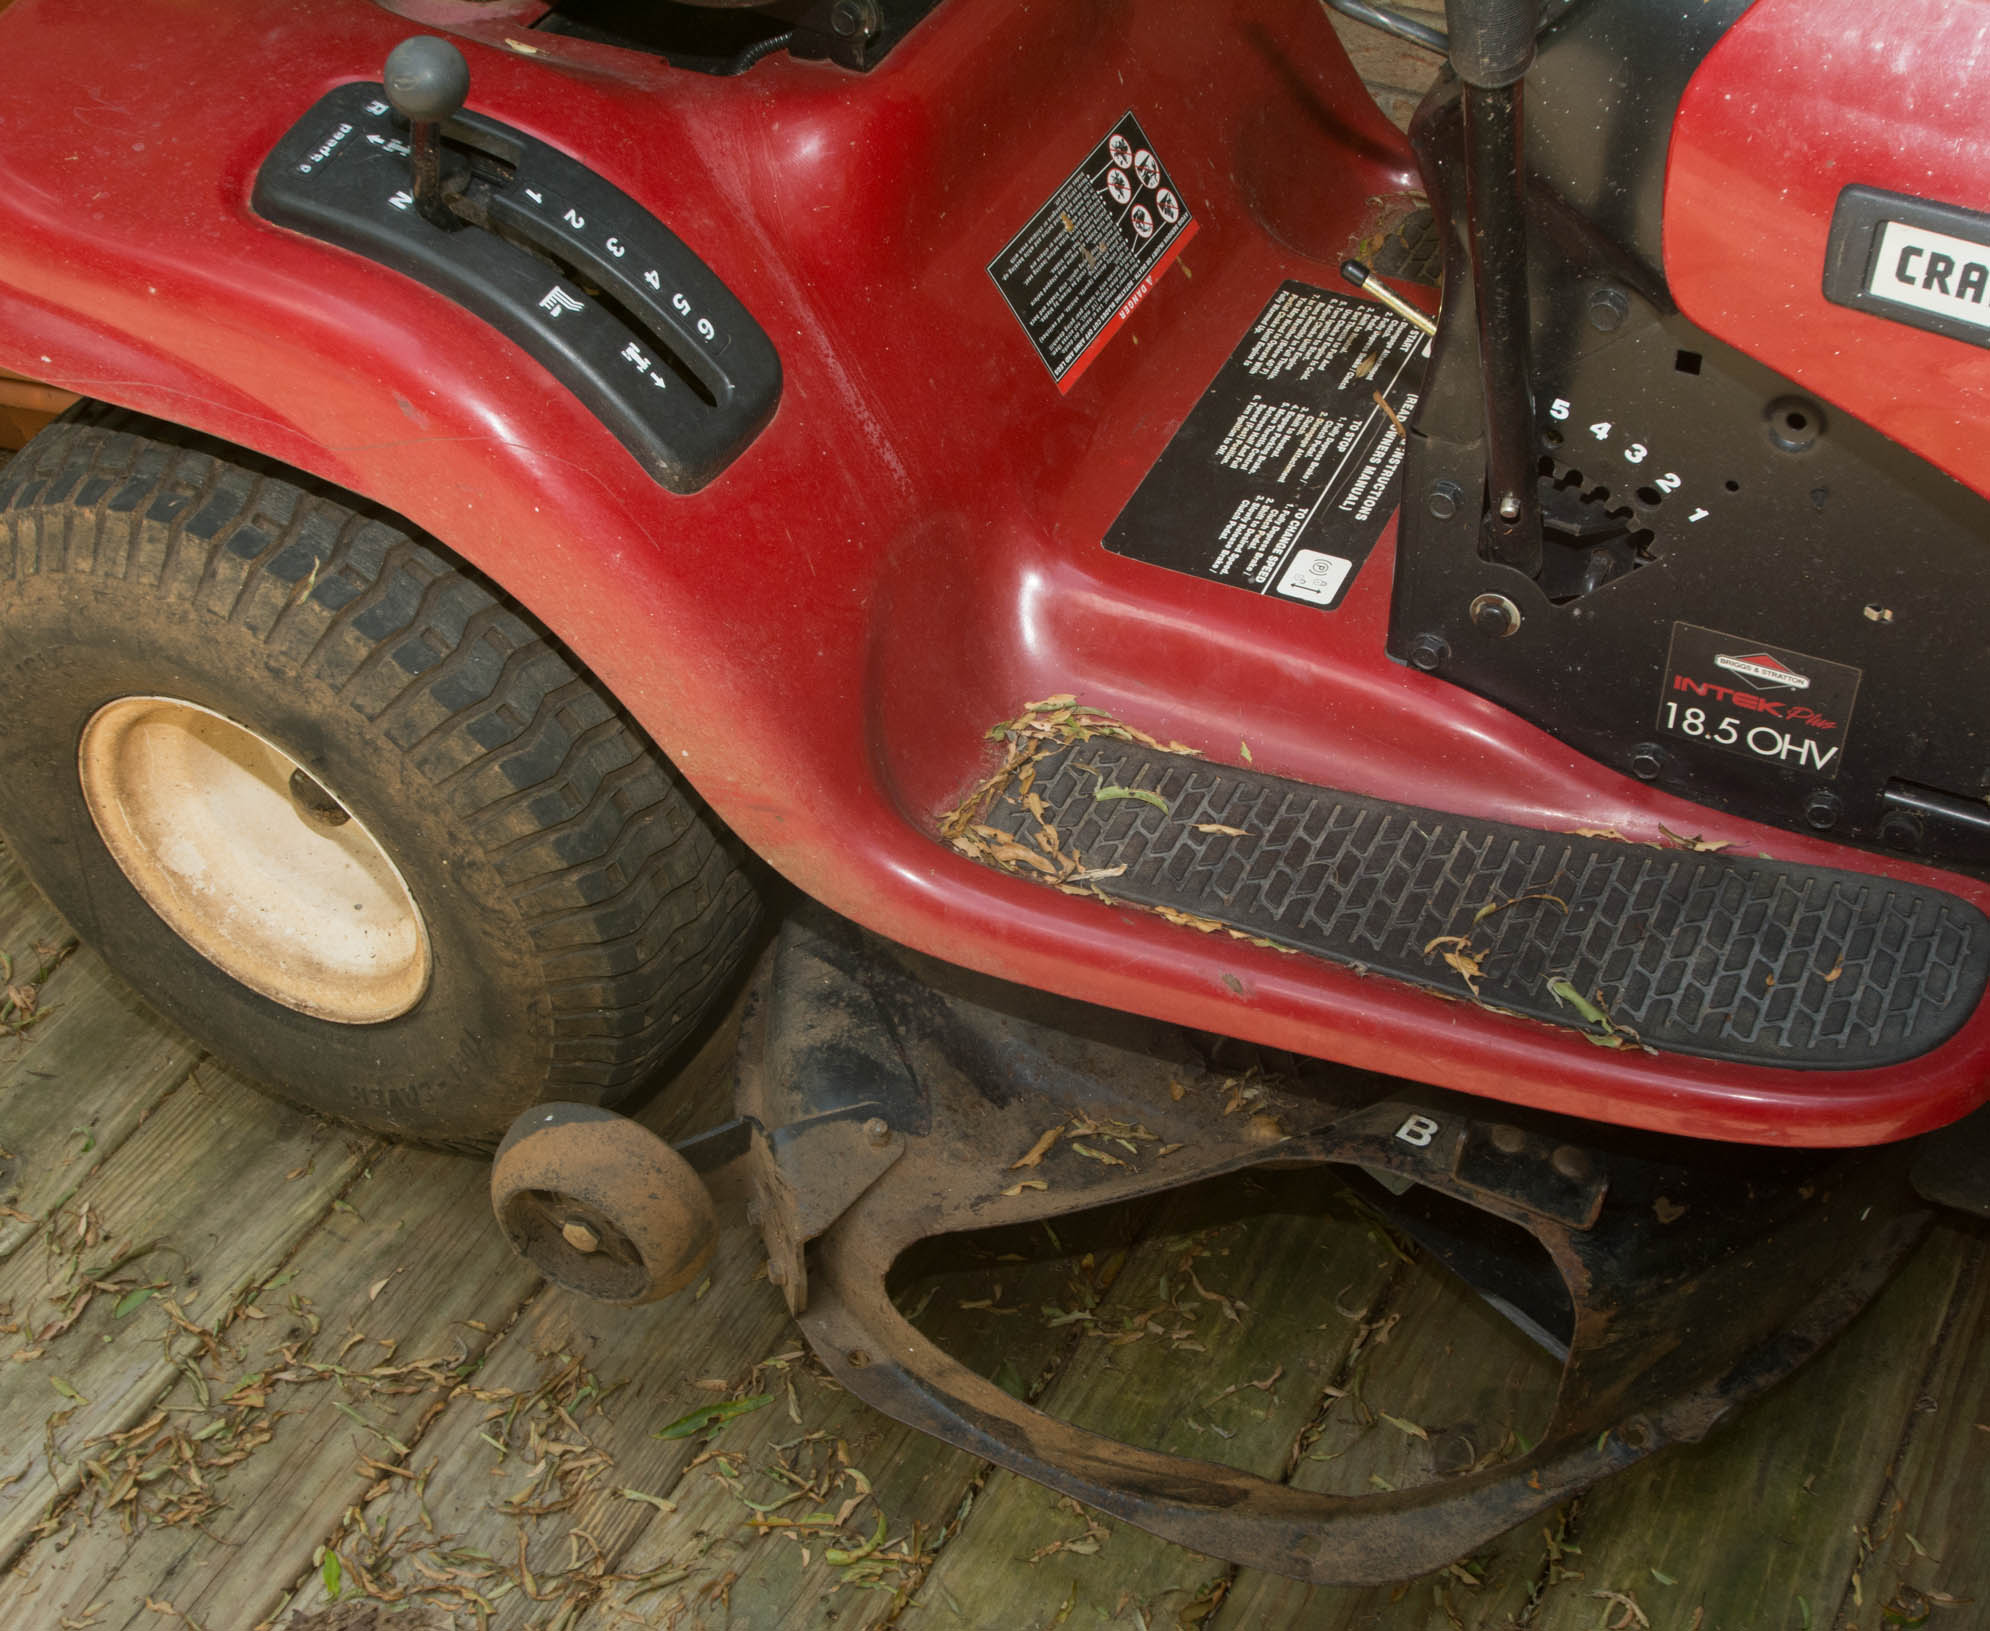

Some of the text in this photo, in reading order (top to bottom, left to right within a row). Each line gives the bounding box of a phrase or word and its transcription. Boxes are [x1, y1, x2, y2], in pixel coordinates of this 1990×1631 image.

[364, 100, 389, 115] R
[388, 190, 413, 210] N
[525, 188, 543, 204] 1
[563, 209, 585, 229] 2
[606, 237, 625, 257] 3
[644, 270, 661, 290] 4
[672, 293, 692, 316] 5
[1119, 284, 1147, 319] DANGER
[697, 318, 715, 340] 6
[1399, 329, 1420, 352] START
[1054, 360, 1066, 376] LEGS
[1242, 401, 1257, 414] Turn
[1249, 403, 1267, 422] Speed
[1270, 408, 1286, 424] Move
[1550, 398, 1571, 420] 5
[1227, 415, 1248, 437] Ignition
[1276, 411, 1295, 432] Engage
[1295, 415, 1314, 436] Clutch.
[1299, 417, 1324, 448] Disengage
[1328, 422, 1343, 437] Fully
[1589, 422, 1612, 440] 4
[1229, 406, 1276, 469] Between Half And Full
[1254, 424, 1276, 447] Throttle
[1260, 432, 1281, 455] Parking
[1304, 420, 1334, 458] Clutch Pedal.
[1335, 420, 1362, 452] TO STOP
[1239, 448, 1260, 470] Control
[1313, 437, 1334, 461] Depress
[1624, 443, 1648, 464] 3
[1247, 455, 1266, 475] Brake.
[1276, 448, 1304, 483] Attachment
[1302, 461, 1319, 479] Brake
[1338, 465, 1376, 511] MANUAL)
[1655, 472, 1682, 494] 2
[1218, 499, 1250, 540] Clutch Pedal.
[1240, 502, 1260, 523] Slowly
[1254, 504, 1270, 520] Shift
[1274, 510, 1290, 525] Fully
[1688, 507, 1710, 523] 1
[1224, 523, 1247, 548] Release
[1233, 528, 1255, 553] Desired
[1247, 509, 1279, 550] Clutch Pedal.
[1258, 525, 1280, 551] Depress
[1254, 508, 1309, 583] TO CHANGE SPEED
[1211, 549, 1230, 569] Brake
[1219, 552, 1239, 575] Speed.
[1245, 552, 1264, 571] Brake
[1719, 657, 1754, 671] BRIGGS
[1761, 667, 1805, 685] STRATTON
[1673, 674, 1837, 729] INTEK Plus
[1666, 701, 1839, 771] 18.5 OHV
[1395, 1113, 1438, 1147] B
